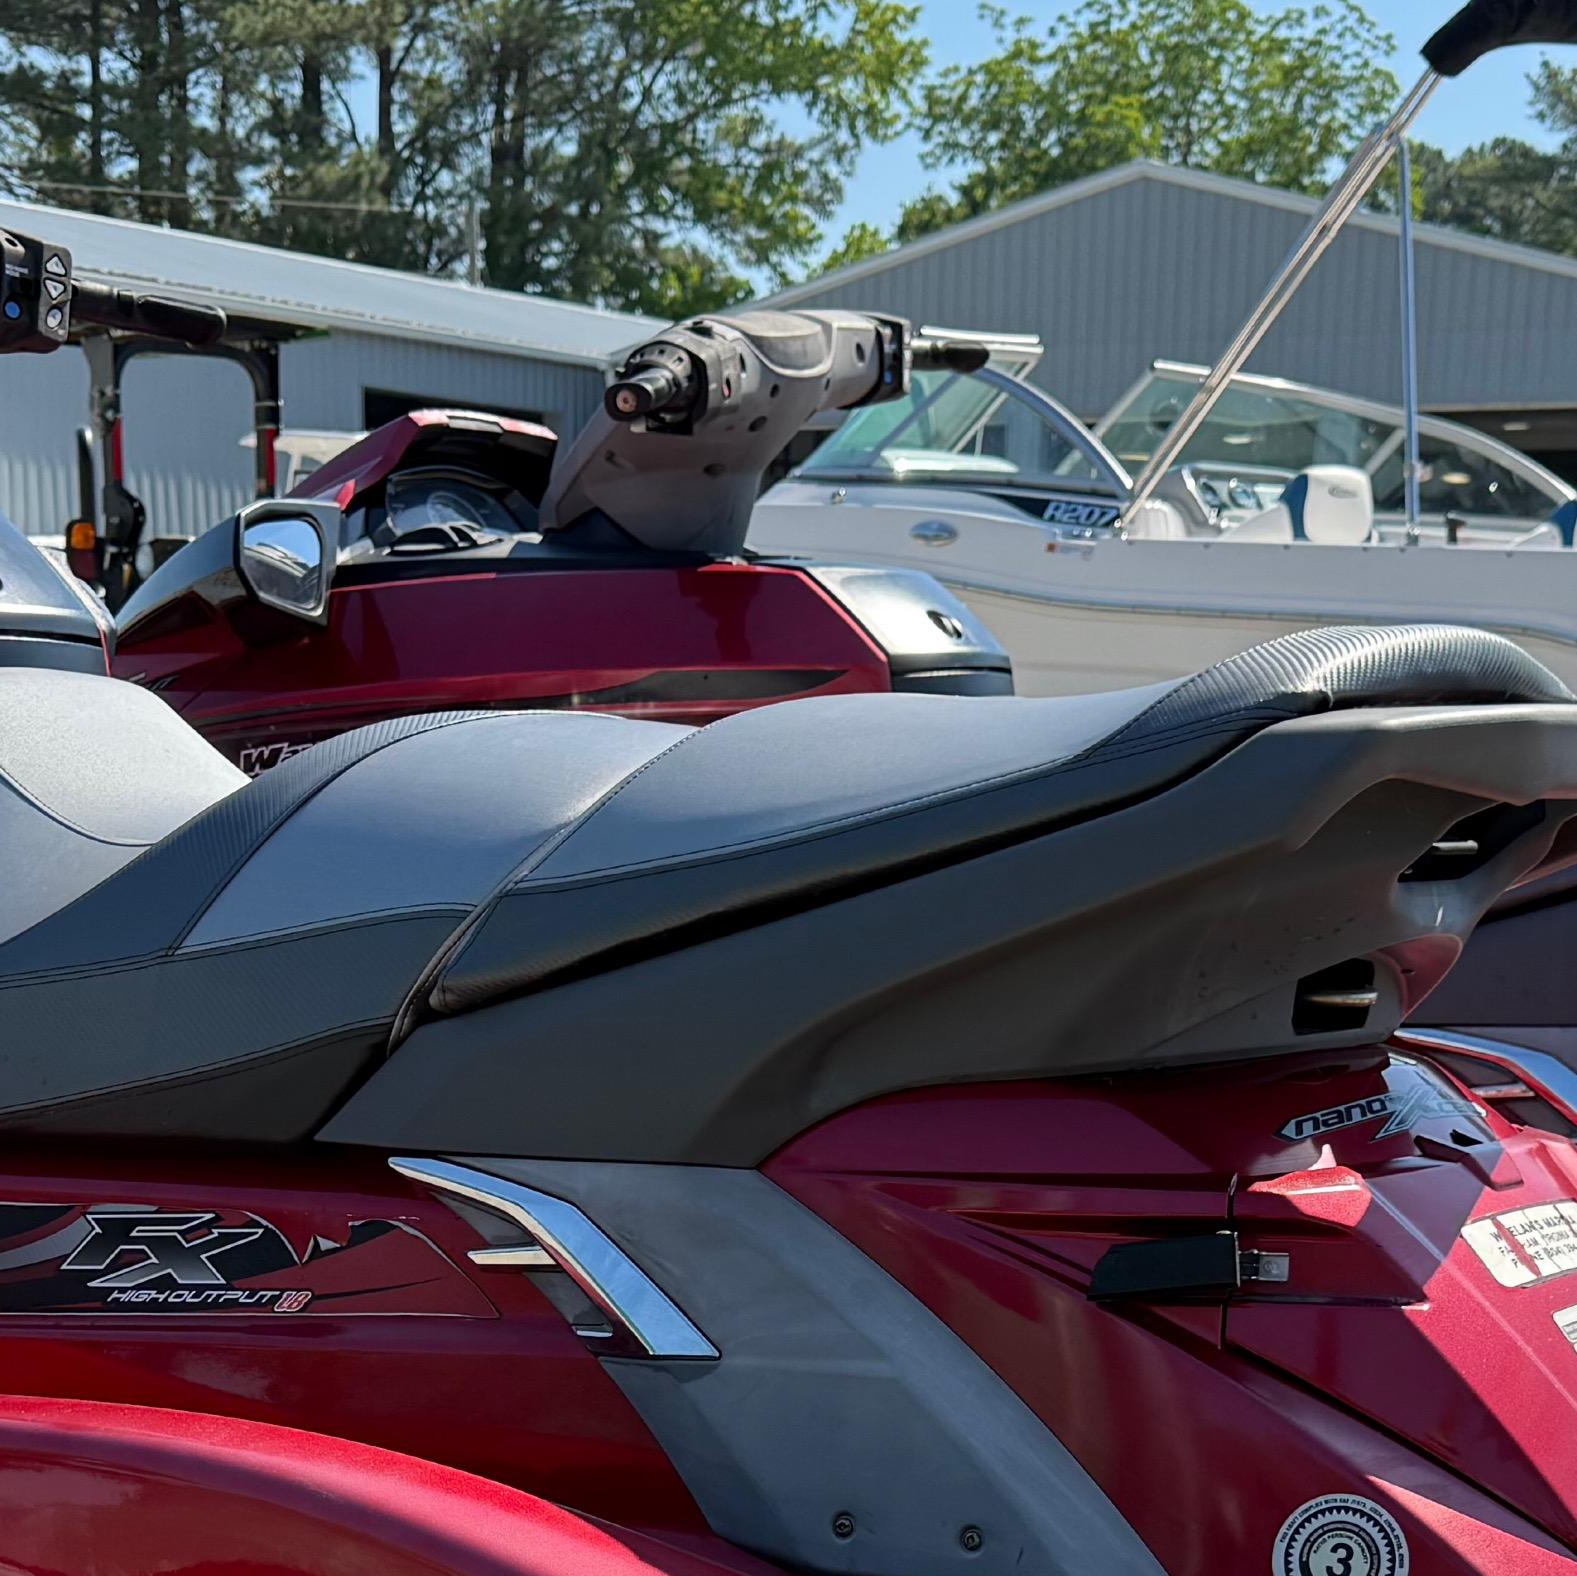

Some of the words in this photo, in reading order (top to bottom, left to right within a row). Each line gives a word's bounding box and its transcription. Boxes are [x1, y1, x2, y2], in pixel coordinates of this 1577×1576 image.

[59, 1212, 265, 1288] FX
[106, 1289, 167, 1303] HIGH
[167, 1289, 281, 1303] OUTPUT
